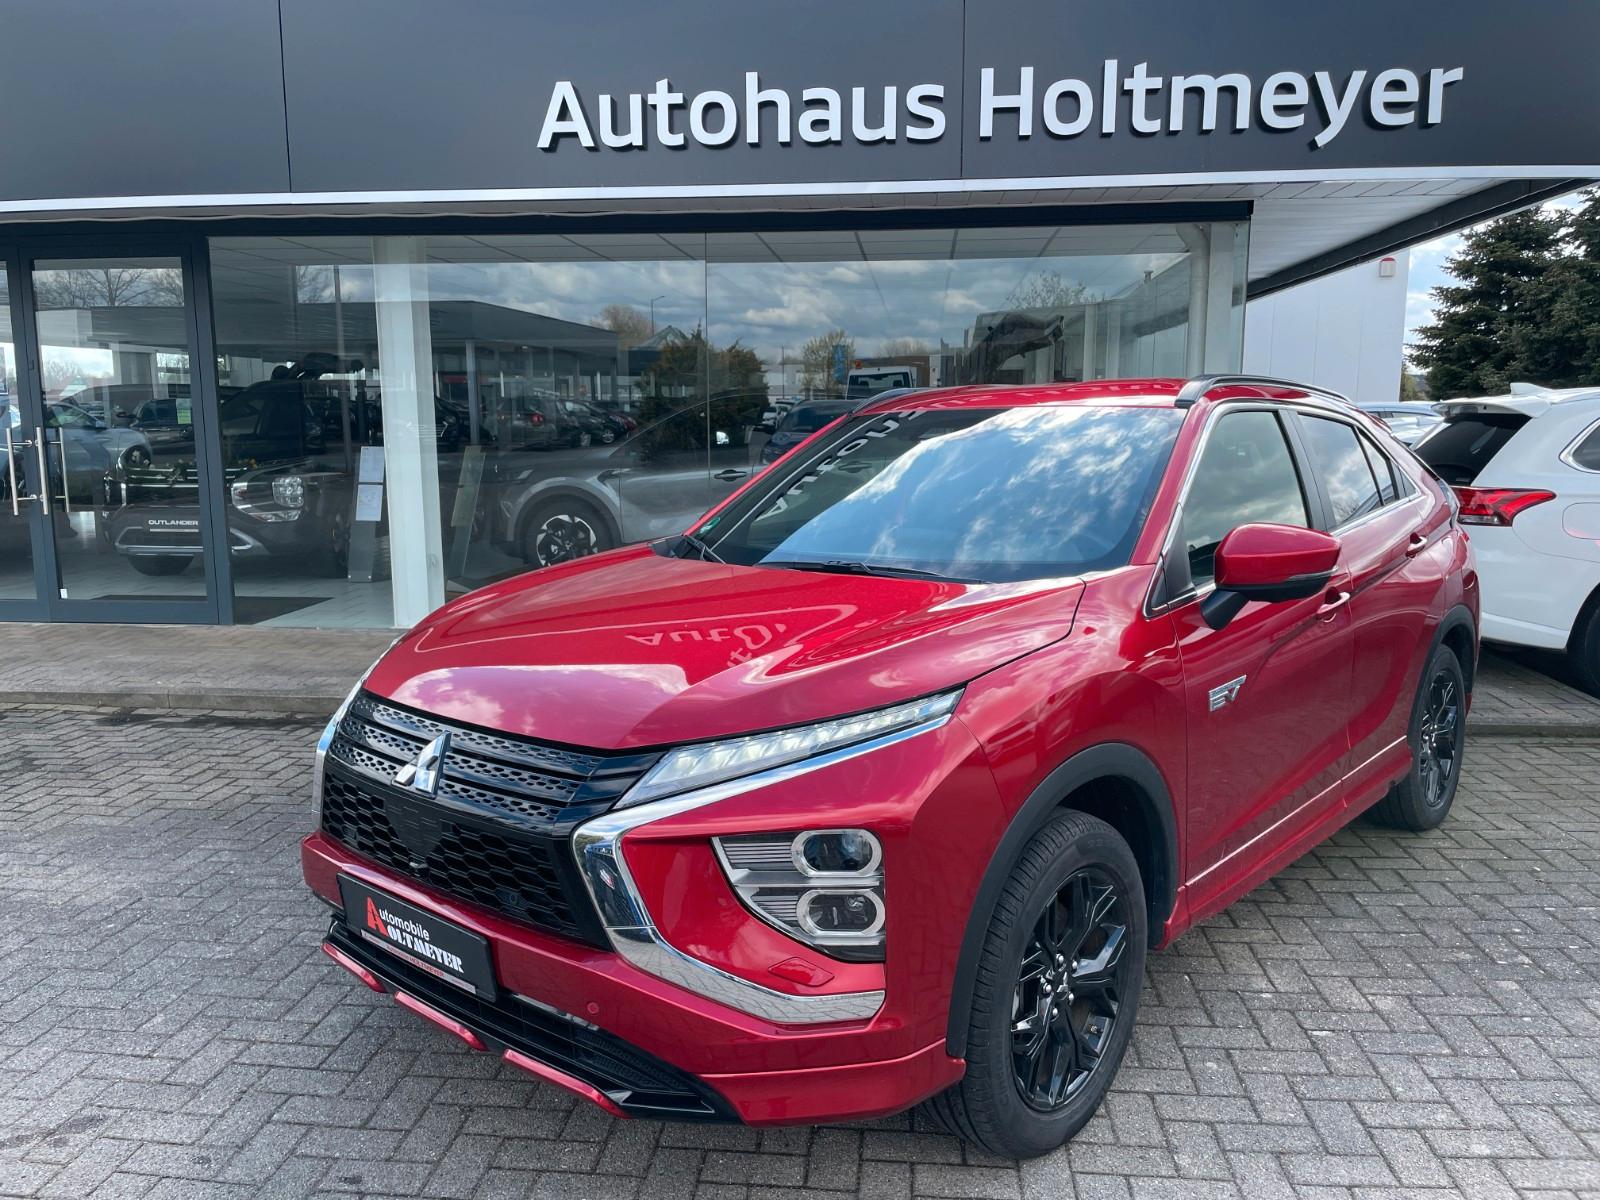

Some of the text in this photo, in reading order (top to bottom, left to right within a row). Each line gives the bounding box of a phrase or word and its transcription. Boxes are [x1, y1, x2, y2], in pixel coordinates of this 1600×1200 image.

[536, 58, 1464, 152] Autohaus Holtmeyer
[367, 896, 431, 940] Automobile
